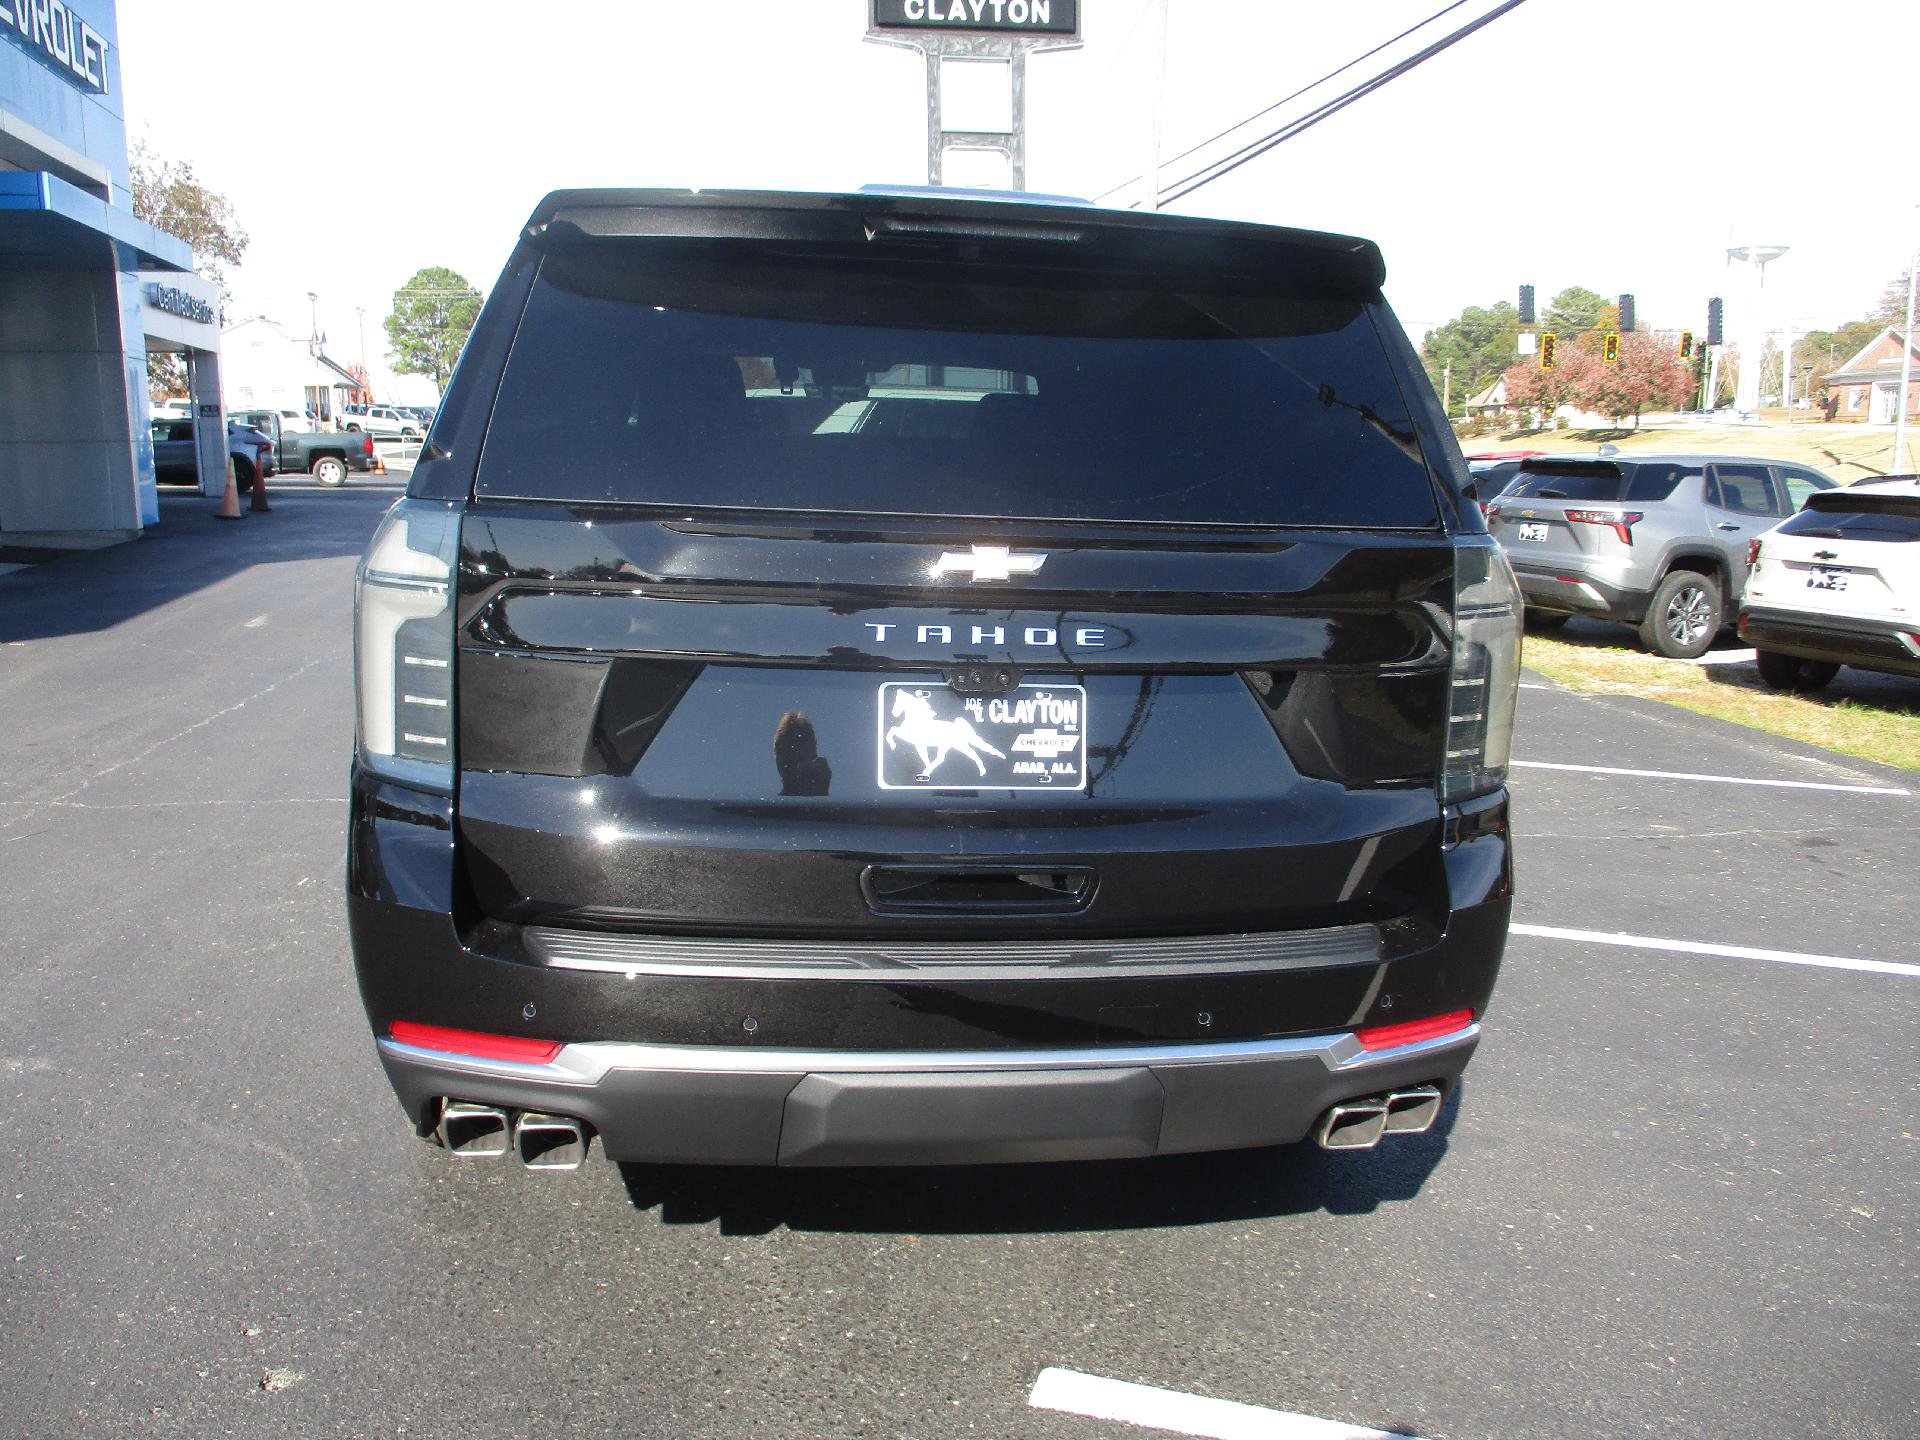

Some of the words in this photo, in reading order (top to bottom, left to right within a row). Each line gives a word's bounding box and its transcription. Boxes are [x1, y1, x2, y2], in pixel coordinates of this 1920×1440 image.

[904, 0, 1050, 23] CLAYTON
[0, 0, 109, 95] VROLET
[865, 623, 1105, 646] TAHOE
[965, 698, 982, 710] JOE
[988, 699, 1077, 724] CLAYTON
[1050, 762, 1078, 774] ALA.
